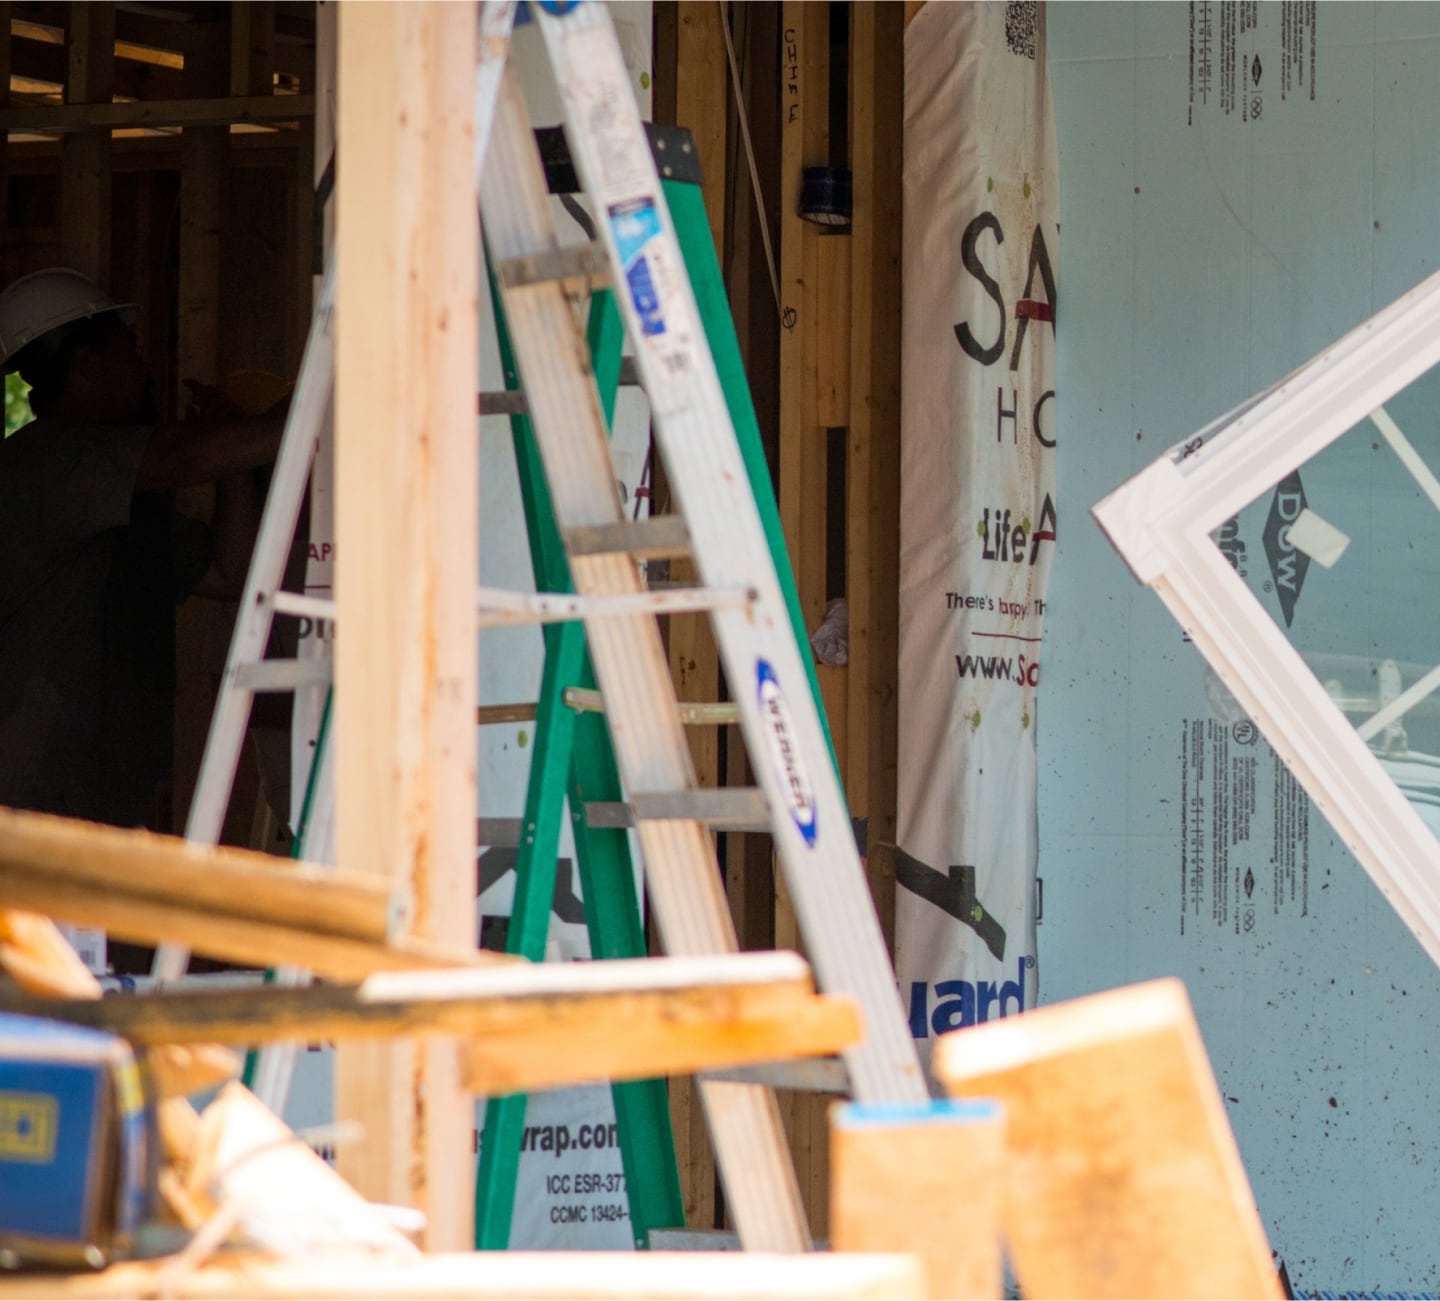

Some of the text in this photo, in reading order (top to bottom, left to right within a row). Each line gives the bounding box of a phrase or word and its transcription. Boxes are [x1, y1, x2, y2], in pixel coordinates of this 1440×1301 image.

[953, 211, 1060, 371] SA
[982, 507, 1026, 563] Life
[945, 592, 994, 611] There's
[546, 1175, 570, 1194] ICC
[551, 1206, 587, 1223] CCMC
